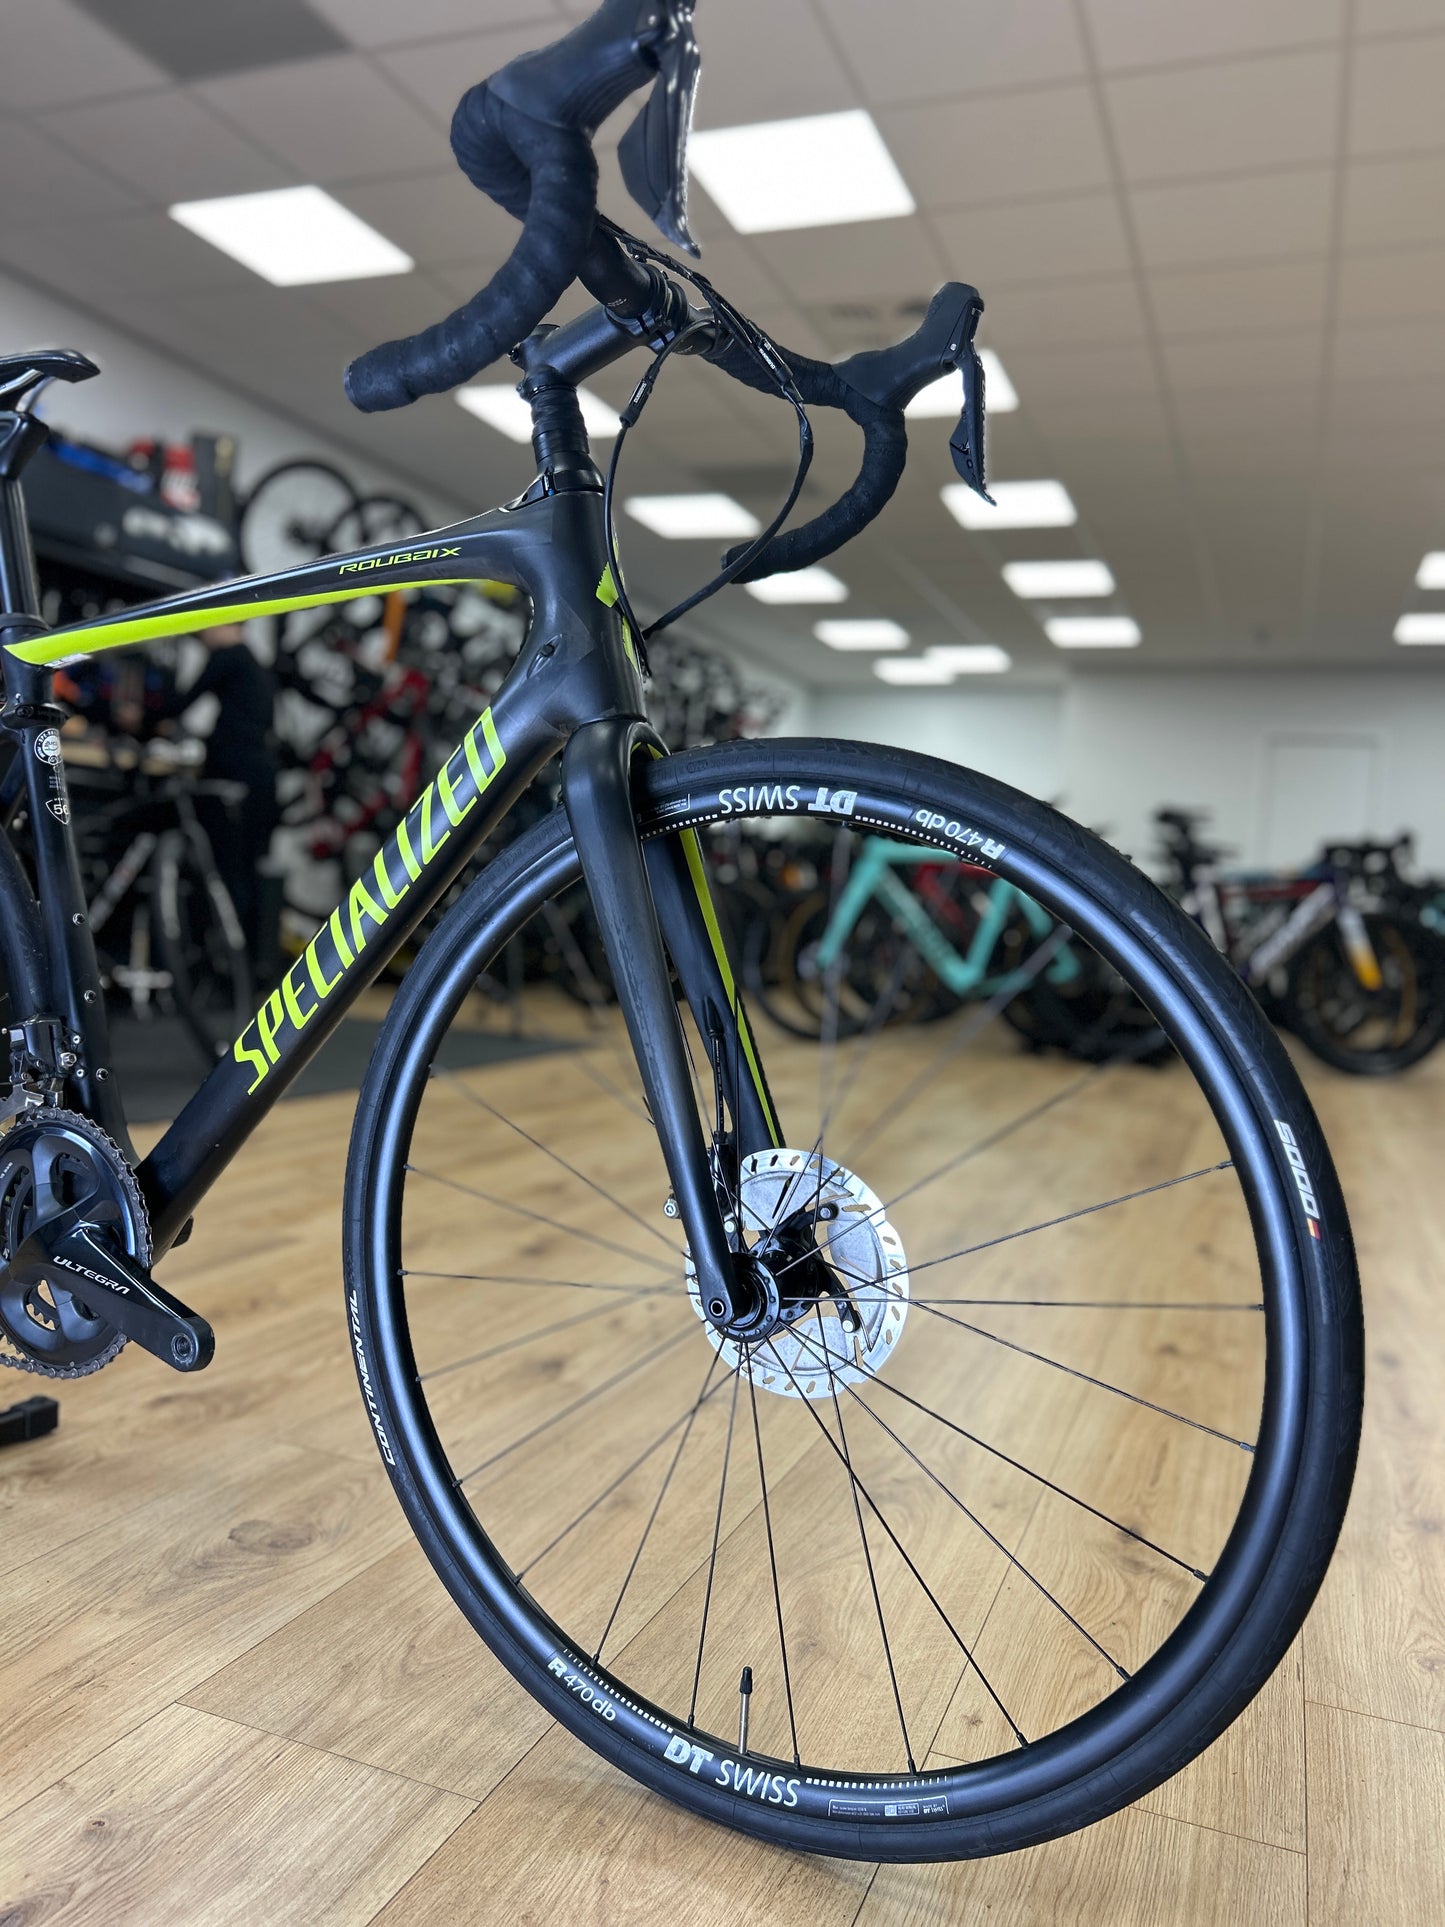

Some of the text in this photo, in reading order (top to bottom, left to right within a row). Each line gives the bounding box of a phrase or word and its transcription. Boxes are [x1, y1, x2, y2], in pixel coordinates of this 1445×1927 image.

[718, 785, 801, 814] SWISS
[807, 787, 858, 815] DT
[233, 706, 507, 1095] SPECIALIZED
[1273, 1119, 1320, 1220] 5000
[53, 1255, 131, 1295] ULTEGRA
[349, 1289, 396, 1467] CONTINENTAL
[663, 1735, 801, 1808] DT SWISS
